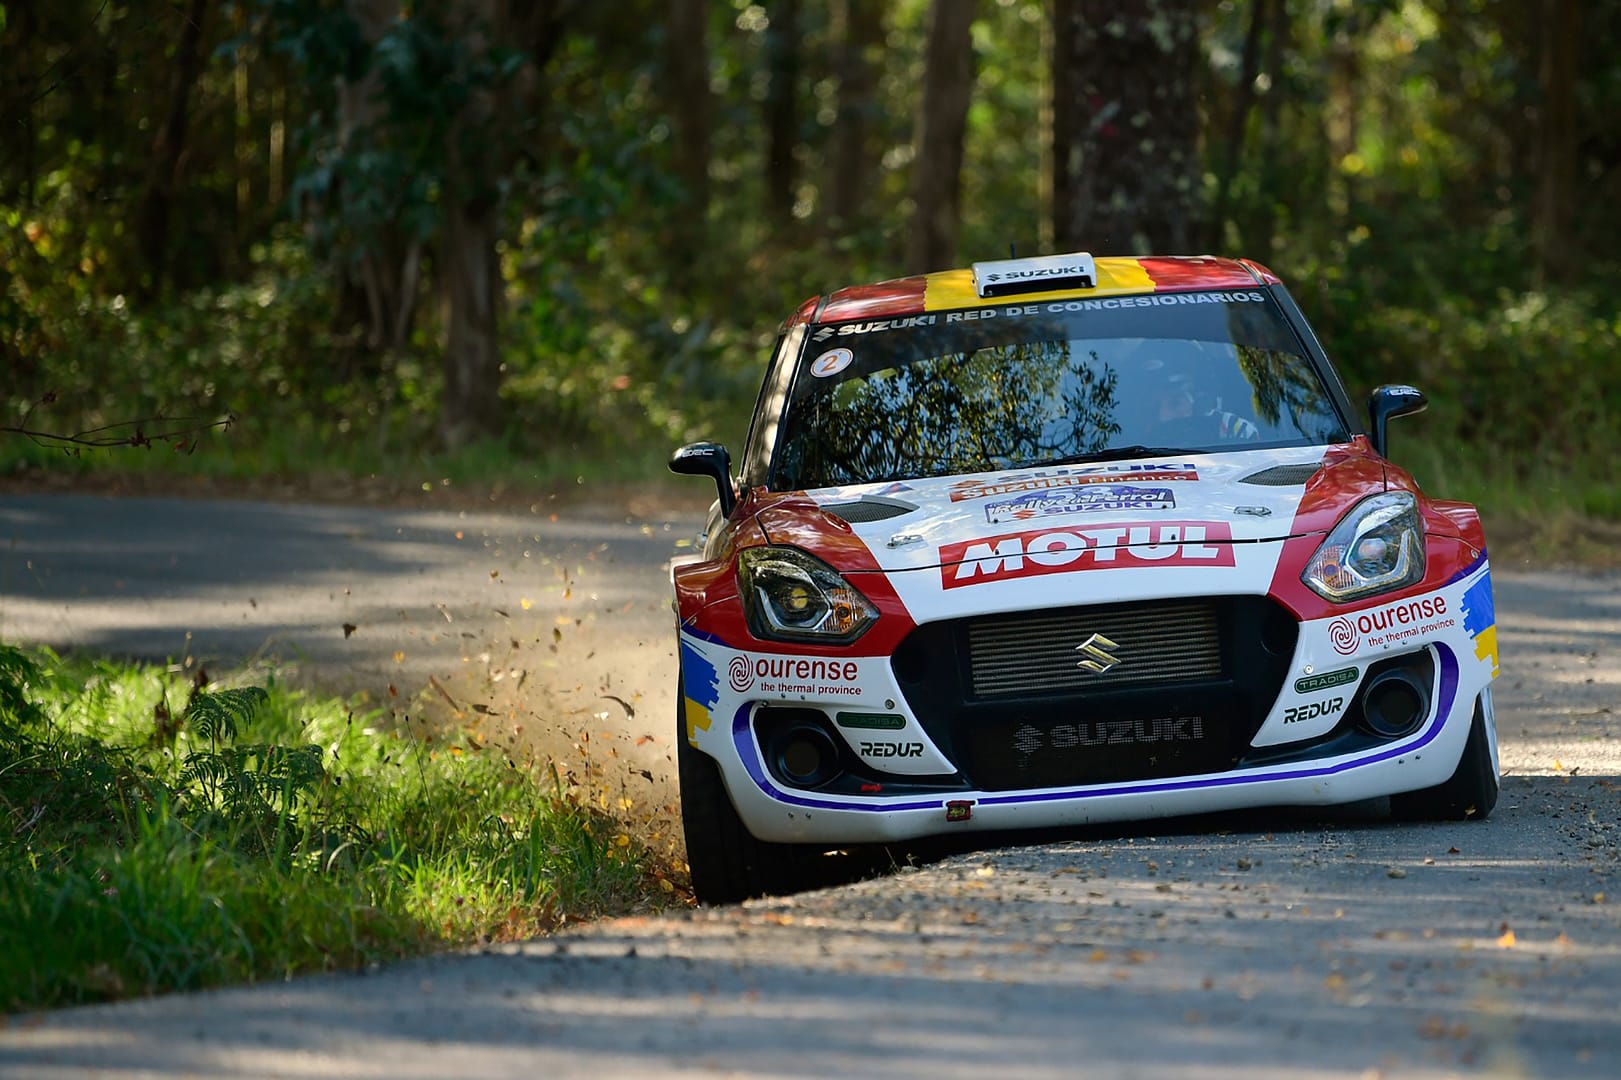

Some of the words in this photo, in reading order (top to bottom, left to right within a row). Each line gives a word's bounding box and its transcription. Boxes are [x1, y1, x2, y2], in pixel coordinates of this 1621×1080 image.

[1005, 265, 1085, 280] SUZUKI
[838, 315, 936, 336] SUZUKI
[946, 309, 997, 323] RED
[1006, 305, 1040, 317] DE
[1047, 292, 1266, 313] CONCESIONARIOS
[820, 354, 839, 373] 2
[998, 463, 1196, 483] SUZUKI
[1044, 501, 1154, 515] SUZUKI
[954, 526, 1220, 580] MOTUL
[1357, 596, 1447, 634] ourense
[1368, 636, 1384, 647] the
[1385, 627, 1419, 643] thermal
[1420, 619, 1455, 636] province
[755, 659, 858, 681] ourense
[1299, 671, 1356, 689] TRADISA
[761, 682, 775, 691] the
[778, 682, 815, 693] thermal
[818, 684, 862, 695] province
[1283, 697, 1344, 725] REDUR
[1050, 716, 1203, 748] SUZUKI
[859, 742, 924, 758] REDUR
